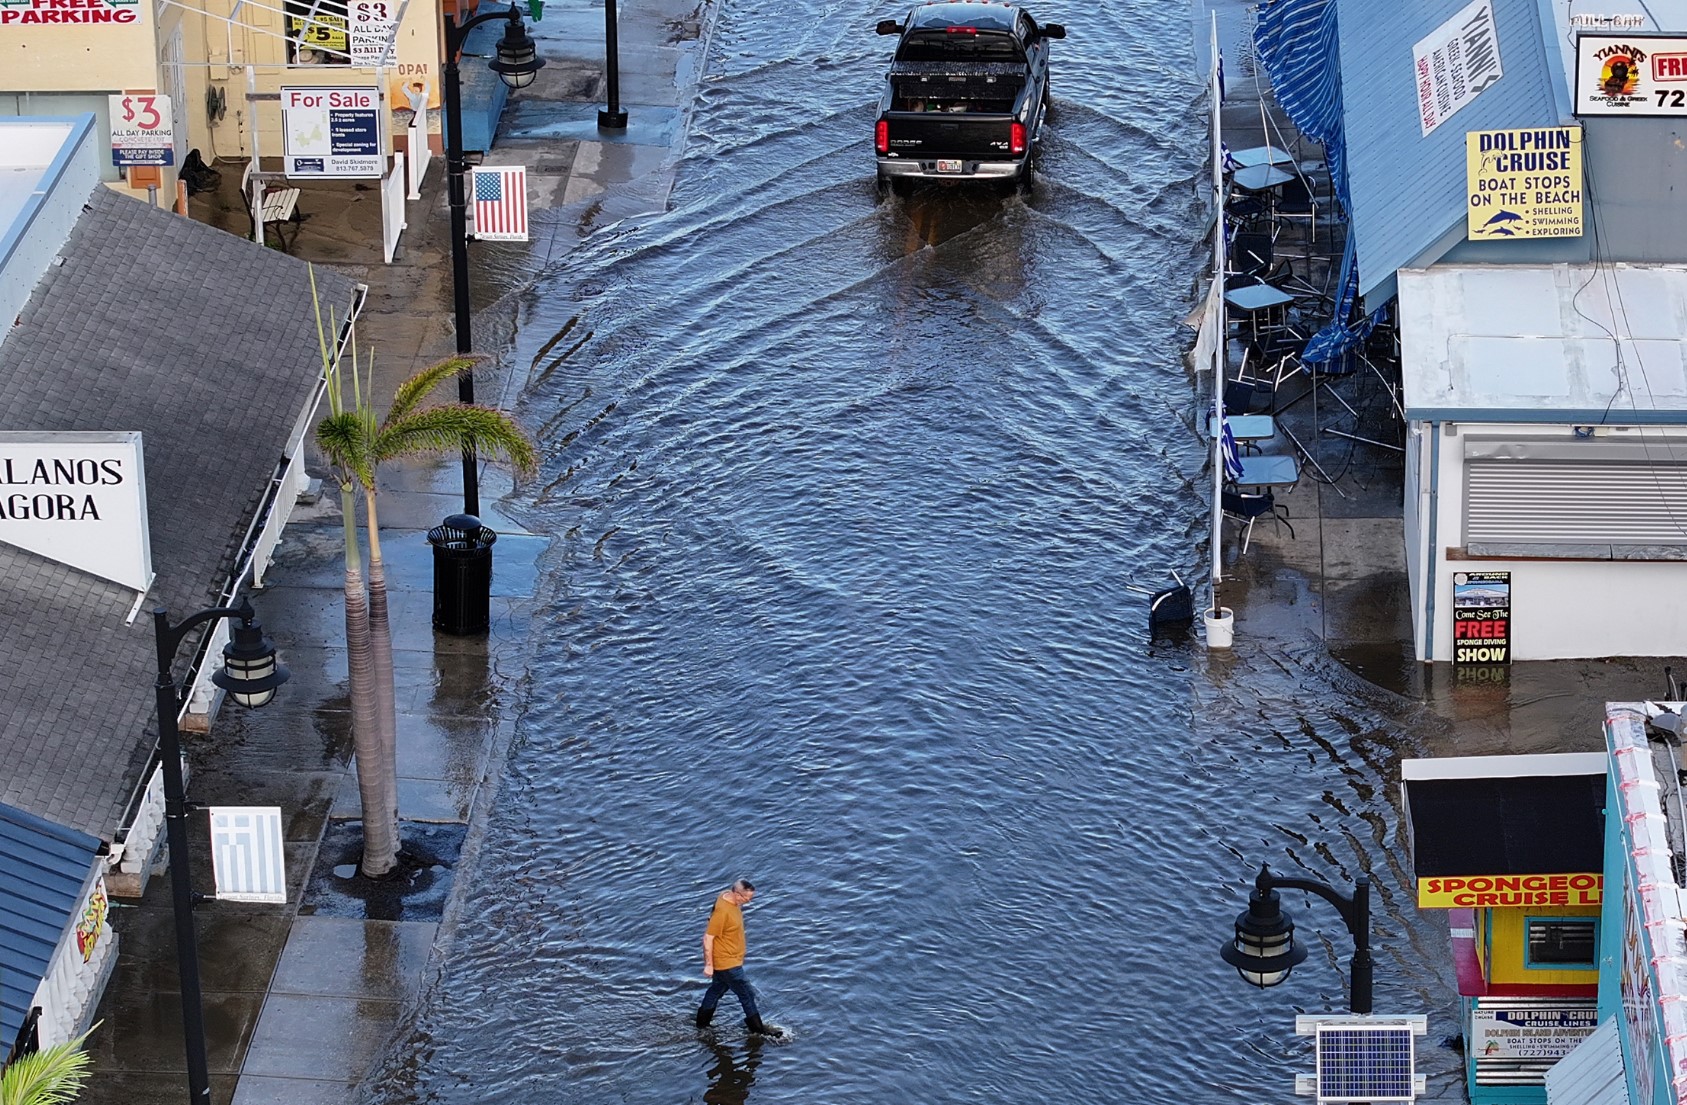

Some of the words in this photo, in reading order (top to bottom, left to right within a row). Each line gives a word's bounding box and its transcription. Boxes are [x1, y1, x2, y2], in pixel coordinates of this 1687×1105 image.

[32, 0, 104, 9] FREE
[357, 2, 387, 22] $3
[1, 10, 137, 24] PARKING
[308, 27, 331, 41] $5
[353, 25, 372, 33] ALL
[353, 35, 395, 44] PARKIN
[1447, 38, 1460, 65] GREEK
[1417, 55, 1429, 80] HAPPY
[1432, 48, 1447, 86] AMERICAN
[1420, 77, 1432, 102] HOUR
[1450, 63, 1466, 101] SEAFOOD
[291, 92, 323, 107] For
[329, 92, 370, 107] Sale
[1422, 100, 1434, 115] ALL
[1436, 83, 1451, 116] CUISINE
[122, 97, 161, 130] $3
[1424, 111, 1436, 129] DAY
[1480, 130, 1570, 152] DOLPHIN
[1496, 151, 1571, 173] CRUISE
[1479, 177, 1516, 191] BOAT
[1525, 175, 1570, 190] STOPS
[1470, 193, 1491, 207] ON
[1500, 192, 1527, 205] THE
[1536, 190, 1580, 204] BEACH
[1533, 207, 1573, 216] SHELLING
[1533, 217, 1579, 225] SWIMMING
[1533, 227, 1580, 235] EXPLORING
[0, 459, 123, 485] LANOS
[1455, 610, 1475, 620] Come
[1476, 610, 1491, 620] See
[1492, 609, 1508, 620] The
[1455, 621, 1506, 638] FREE
[1457, 648, 1506, 662] SHOW
[1427, 874, 1603, 893] SPONGEO
[1453, 892, 1569, 905] CRUISE
[1508, 1011, 1560, 1020] DOLPHIN
[1485, 1029, 1520, 1037] DOLPHIN
[1522, 1029, 1551, 1037] ISLAND
